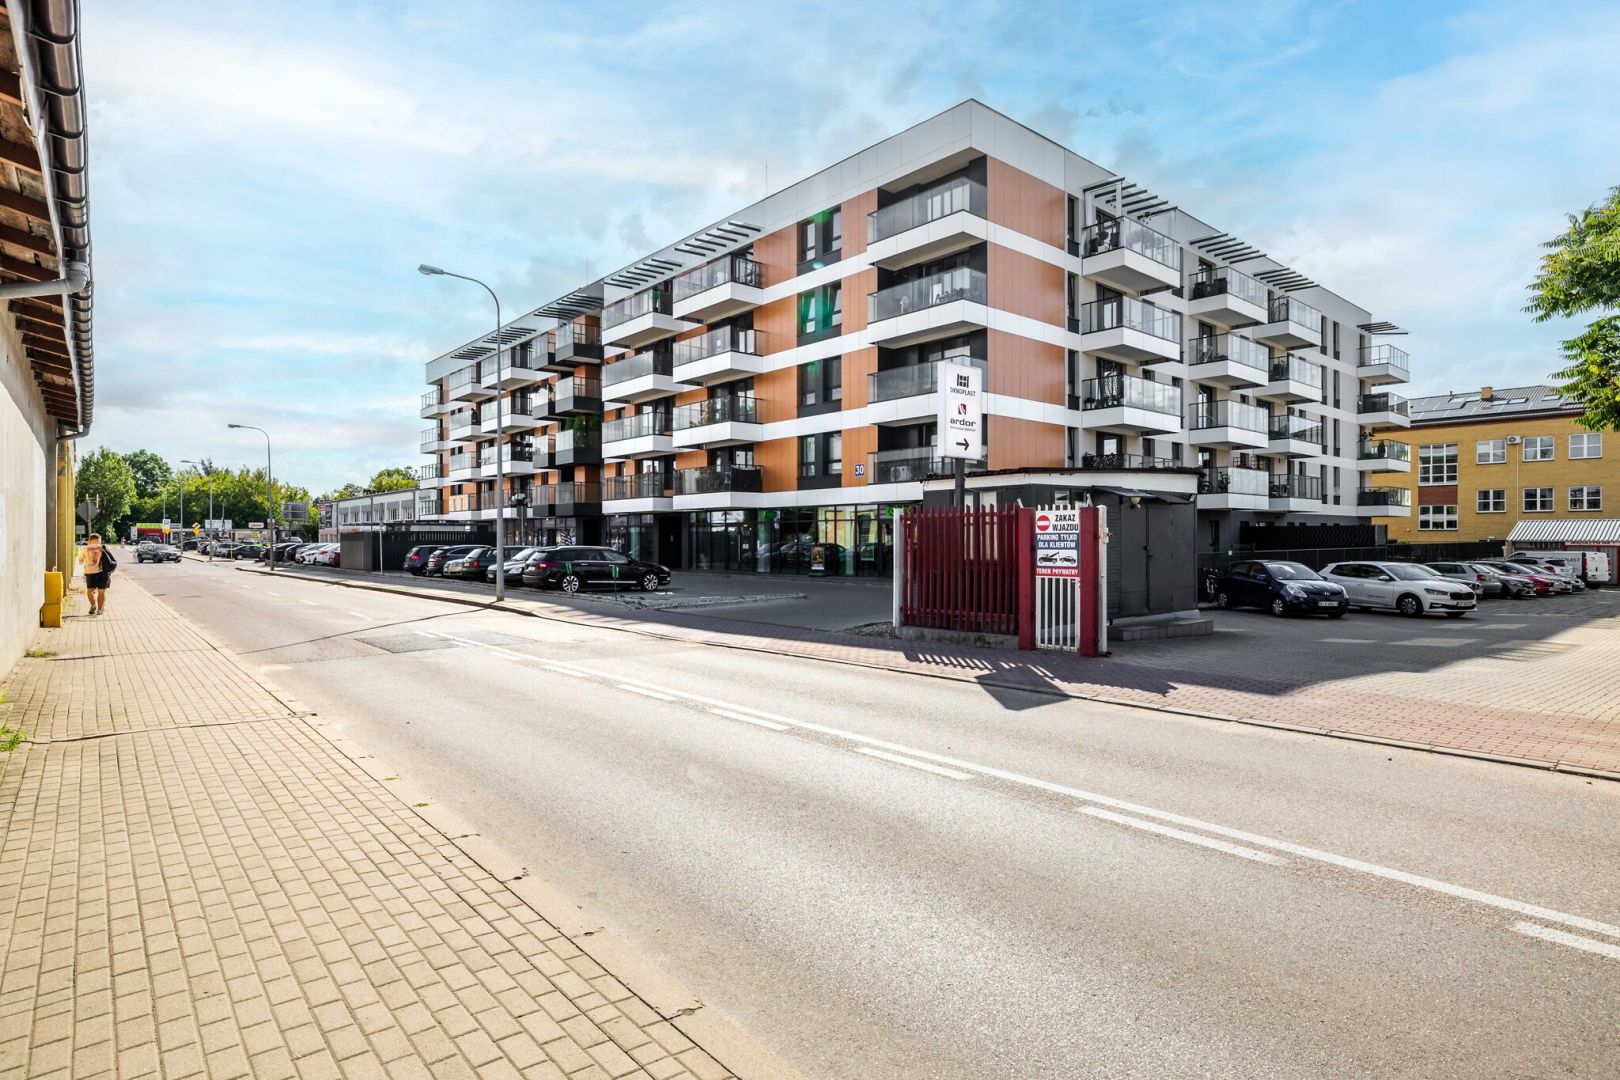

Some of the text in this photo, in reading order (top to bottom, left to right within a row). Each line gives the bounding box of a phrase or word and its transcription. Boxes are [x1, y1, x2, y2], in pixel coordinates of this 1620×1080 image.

[949, 387, 976, 396] OKNOPLAST
[950, 418, 976, 427] ardor
[855, 465, 864, 475] 30
[1055, 514, 1076, 522] ZAKAZ
[1052, 523, 1079, 531] WJAZDU
